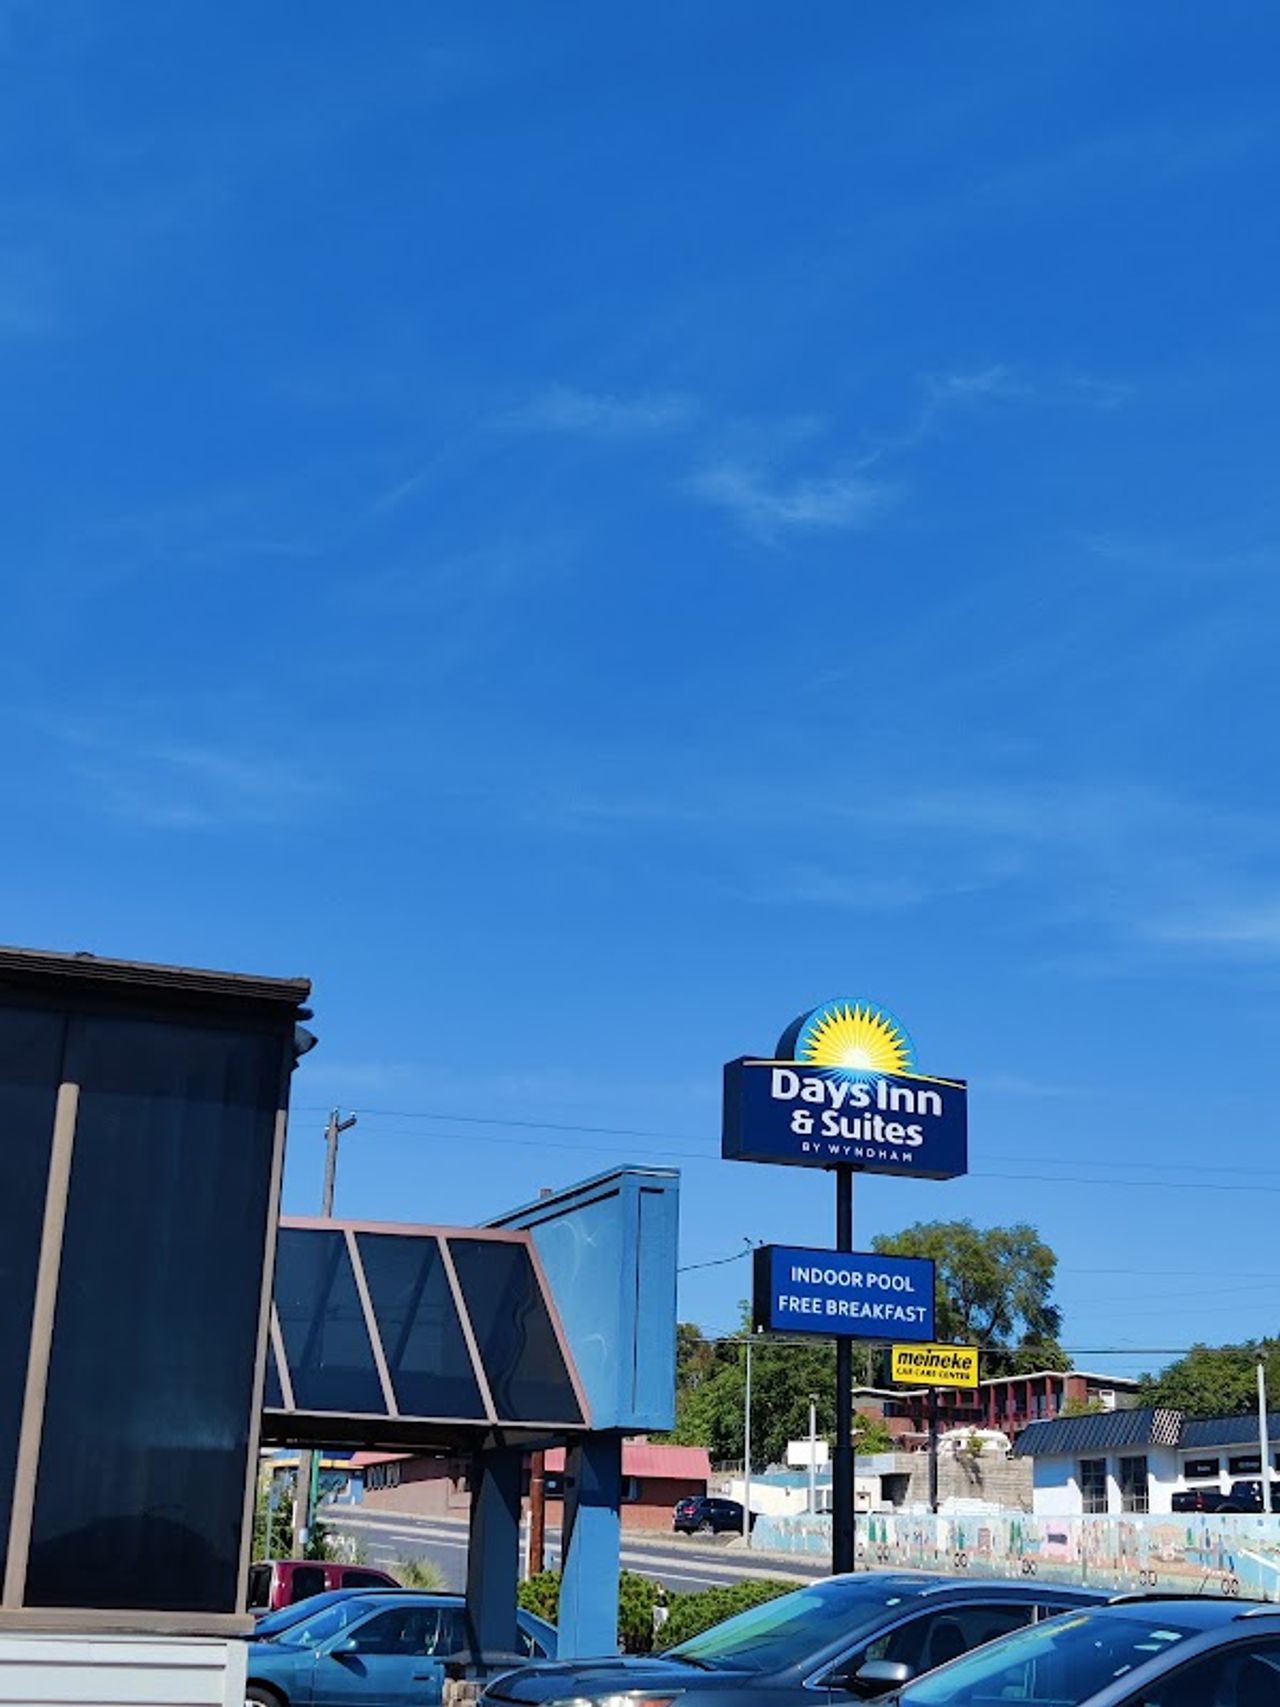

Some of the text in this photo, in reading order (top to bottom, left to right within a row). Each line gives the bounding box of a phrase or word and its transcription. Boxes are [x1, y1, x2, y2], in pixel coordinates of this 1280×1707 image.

[771, 1067, 943, 1117] Days Inn
[790, 1109, 923, 1147] & Suites
[802, 1142, 913, 1162] BY WYNDHAM
[791, 1266, 915, 1292] INDOOR POOL
[778, 1295, 927, 1322] FREE BREAKFAST
[897, 1349, 972, 1370] meineke
